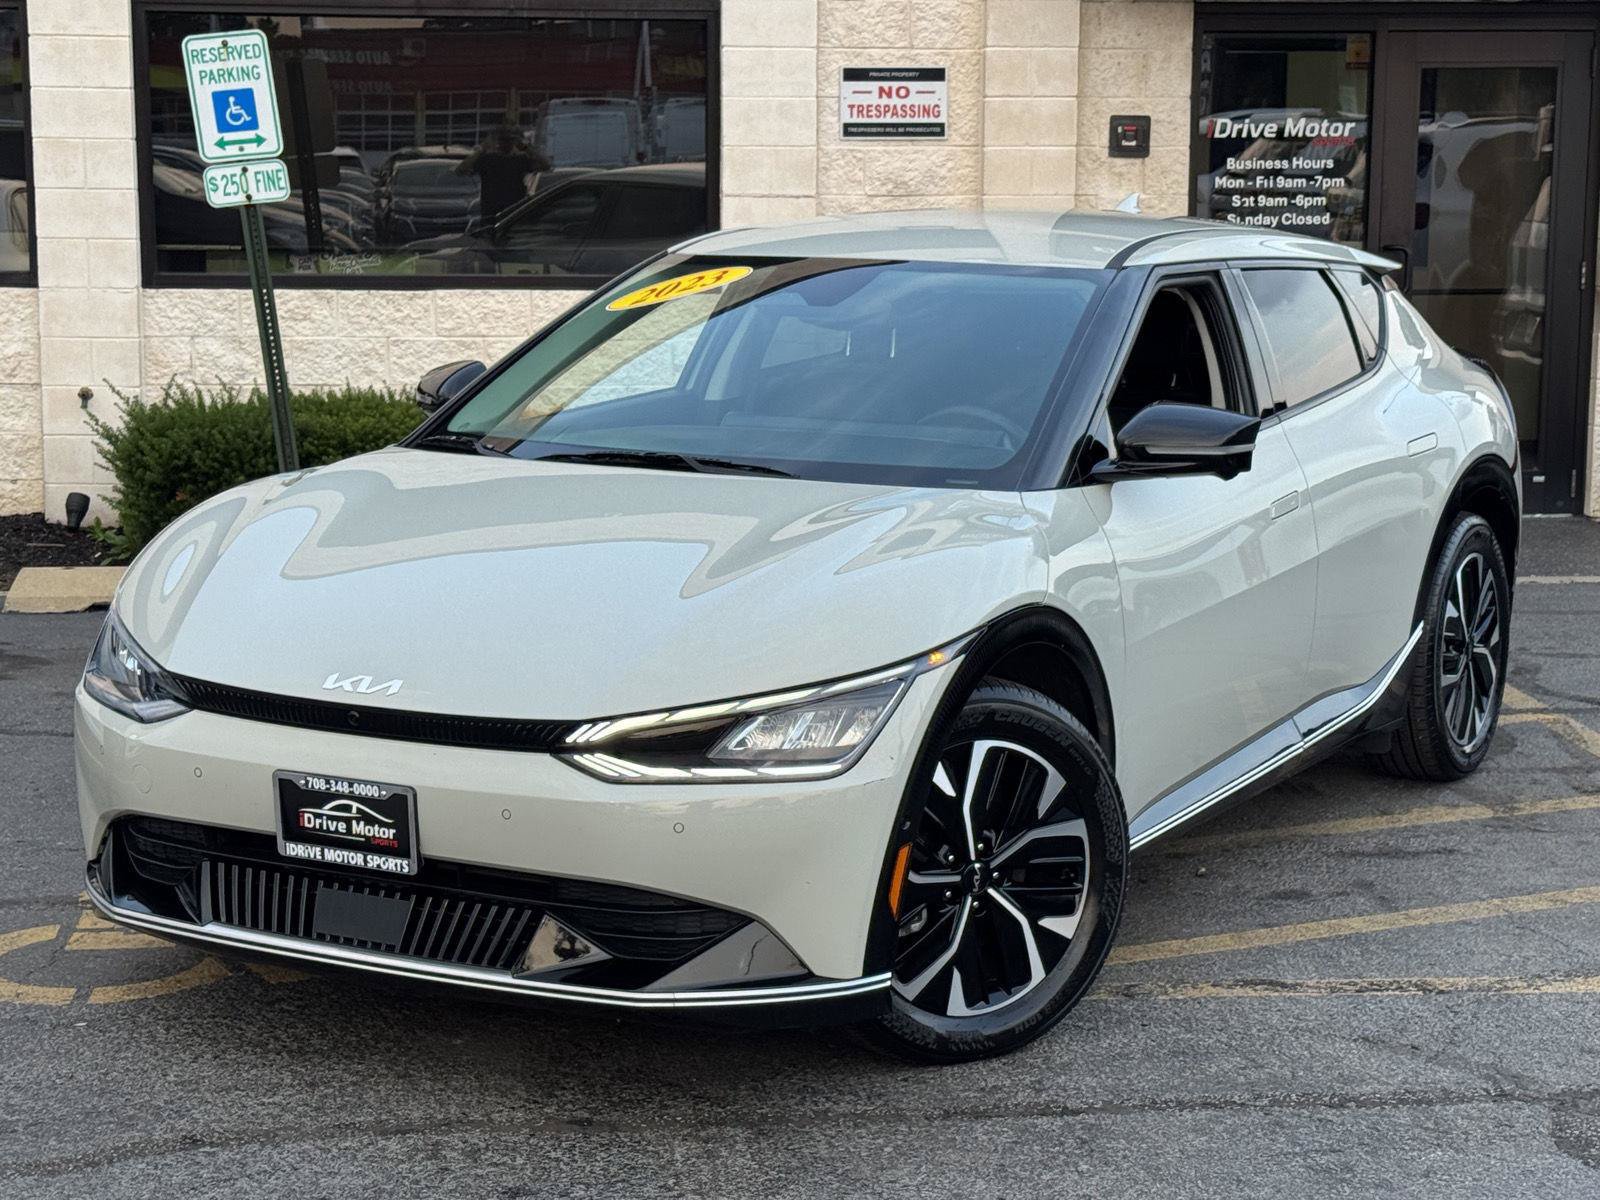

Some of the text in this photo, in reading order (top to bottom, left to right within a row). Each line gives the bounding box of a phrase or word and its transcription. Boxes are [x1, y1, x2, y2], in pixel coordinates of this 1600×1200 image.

[190, 43, 262, 65] RESERVED
[199, 65, 261, 86] PARKING
[878, 85, 910, 100] NO
[847, 103, 941, 119] TRESPASSING
[1283, 117, 1356, 139] Motor
[1226, 157, 1335, 170] Business Hours
[208, 168, 286, 197] $250 FINE
[1214, 176, 1245, 189] Mon
[1276, 176, 1307, 189] 9am
[1257, 195, 1288, 208] 9am
[1281, 212, 1331, 225] Closed
[629, 270, 719, 306] 2023
[306, 776, 380, 798] 708-348-0000
[299, 812, 396, 840] iDrive Motor
[324, 848, 364, 867] MOTOR
[367, 855, 409, 873] SPORTS
